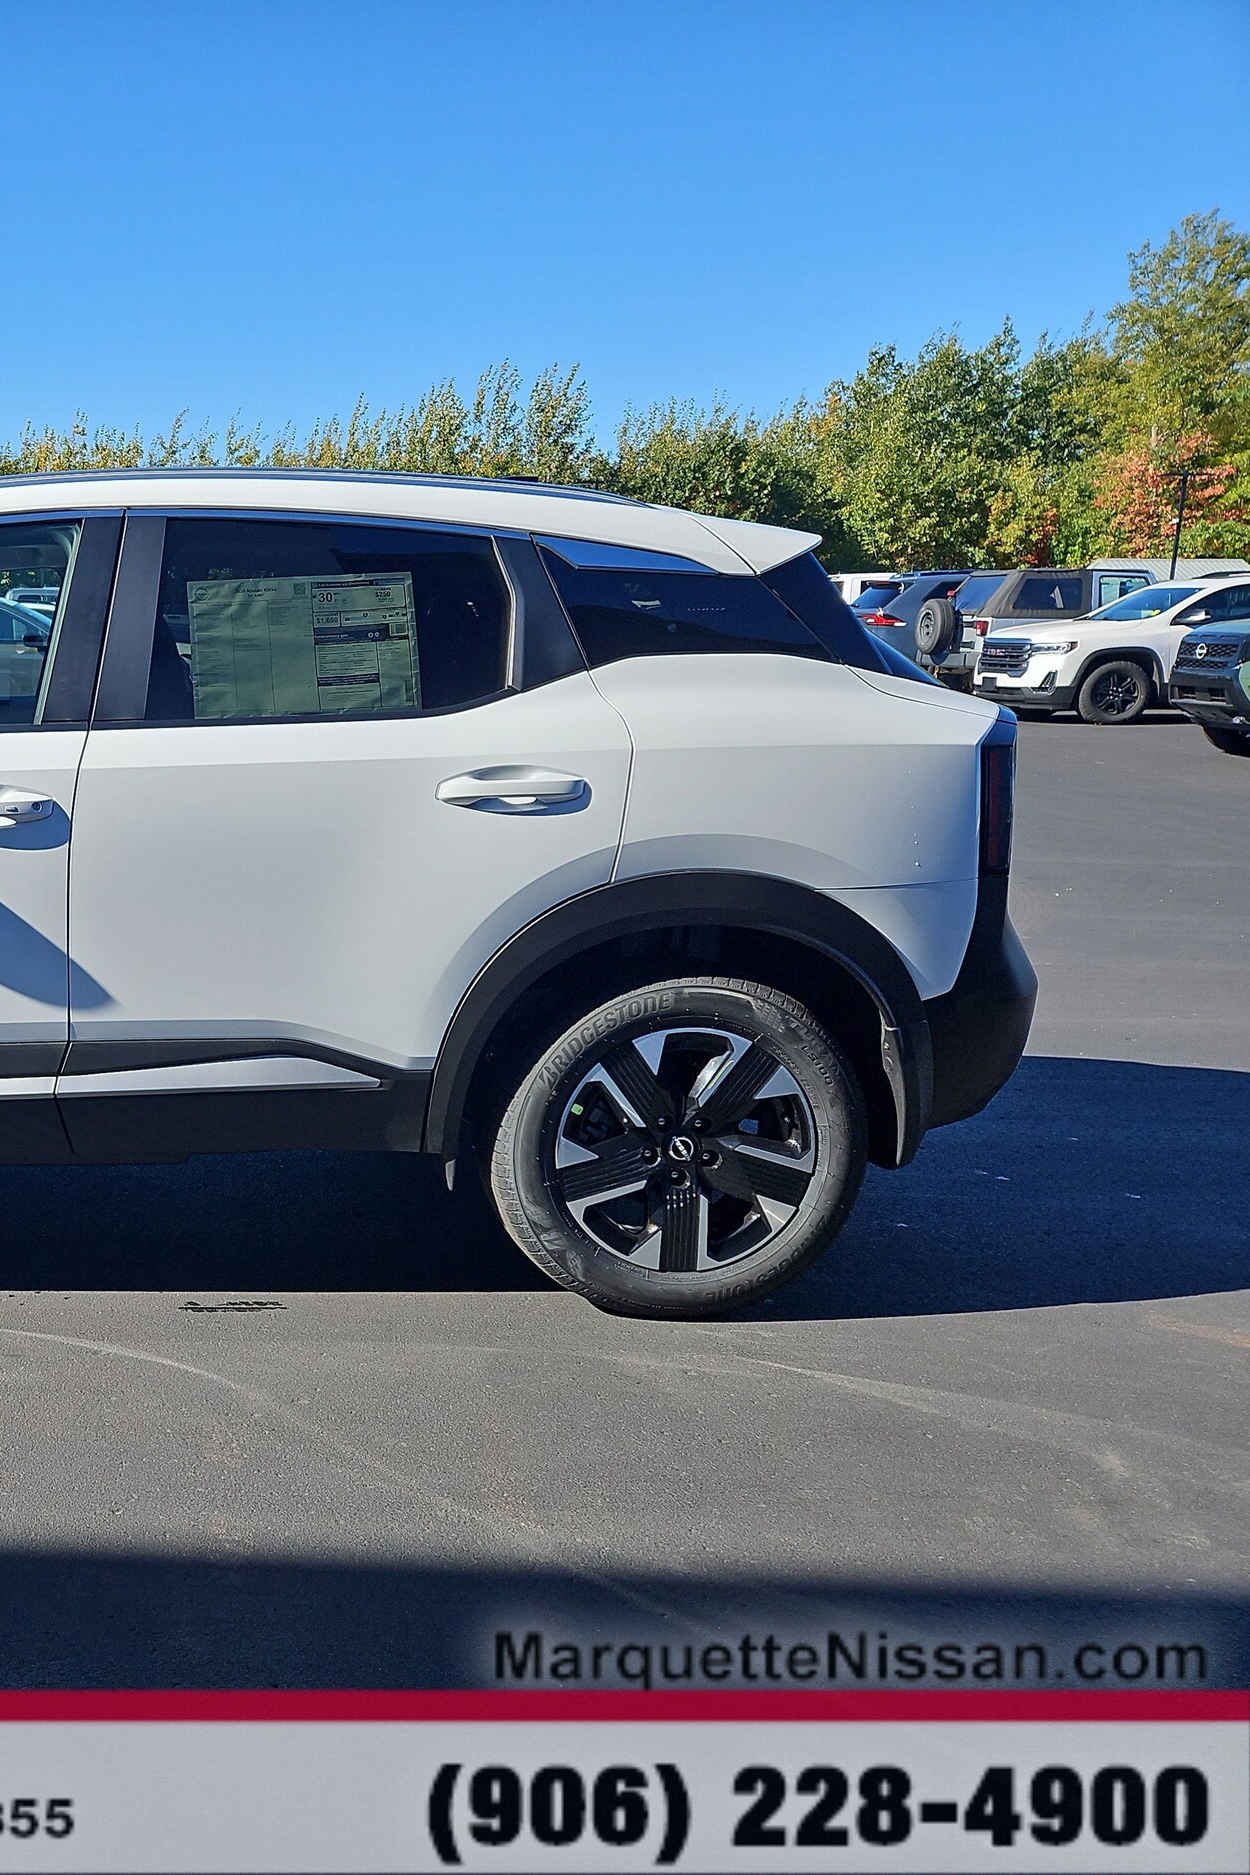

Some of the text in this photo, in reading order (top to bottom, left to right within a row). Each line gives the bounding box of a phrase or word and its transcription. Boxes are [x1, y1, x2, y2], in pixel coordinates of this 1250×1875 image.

[318, 592, 333, 603] 30
[374, 590, 391, 598] $250
[316, 616, 339, 625] $1,650
[538, 992, 672, 1090] BRIDGESTONE
